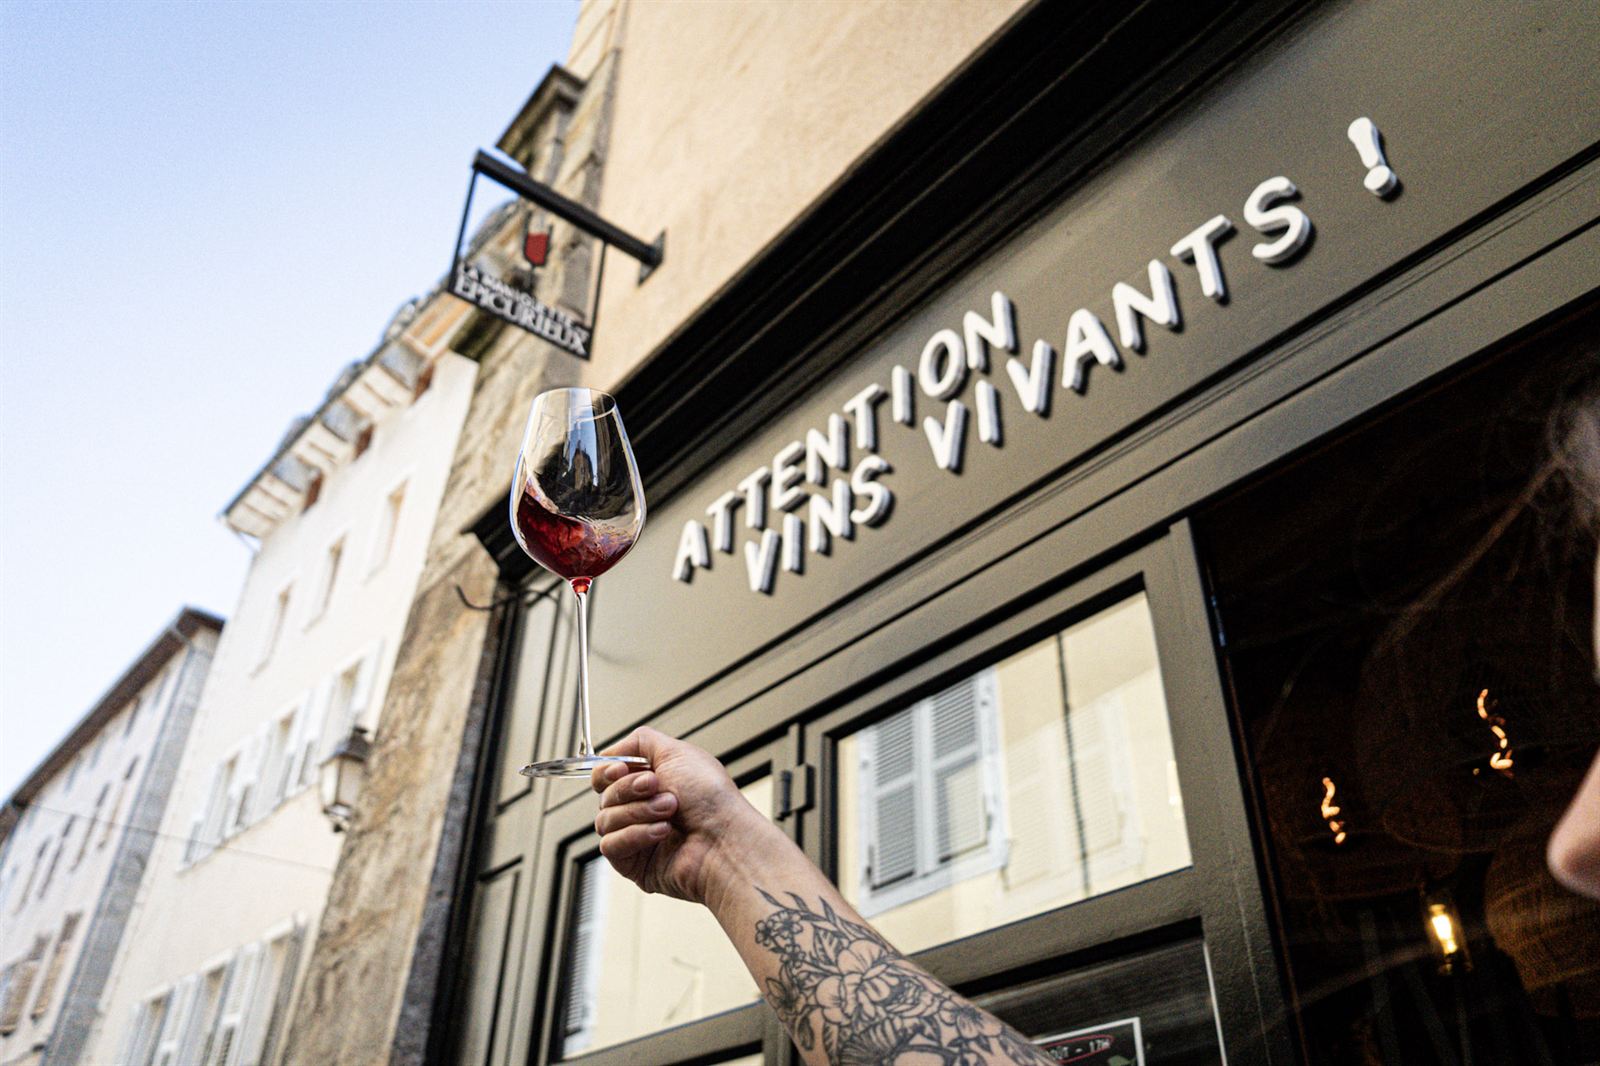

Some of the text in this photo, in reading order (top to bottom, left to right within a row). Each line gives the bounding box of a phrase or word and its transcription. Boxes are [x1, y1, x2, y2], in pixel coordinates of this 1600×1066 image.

[672, 290, 1019, 582] ATTENTION
[744, 116, 1399, 595] VINS VIVANTS !
